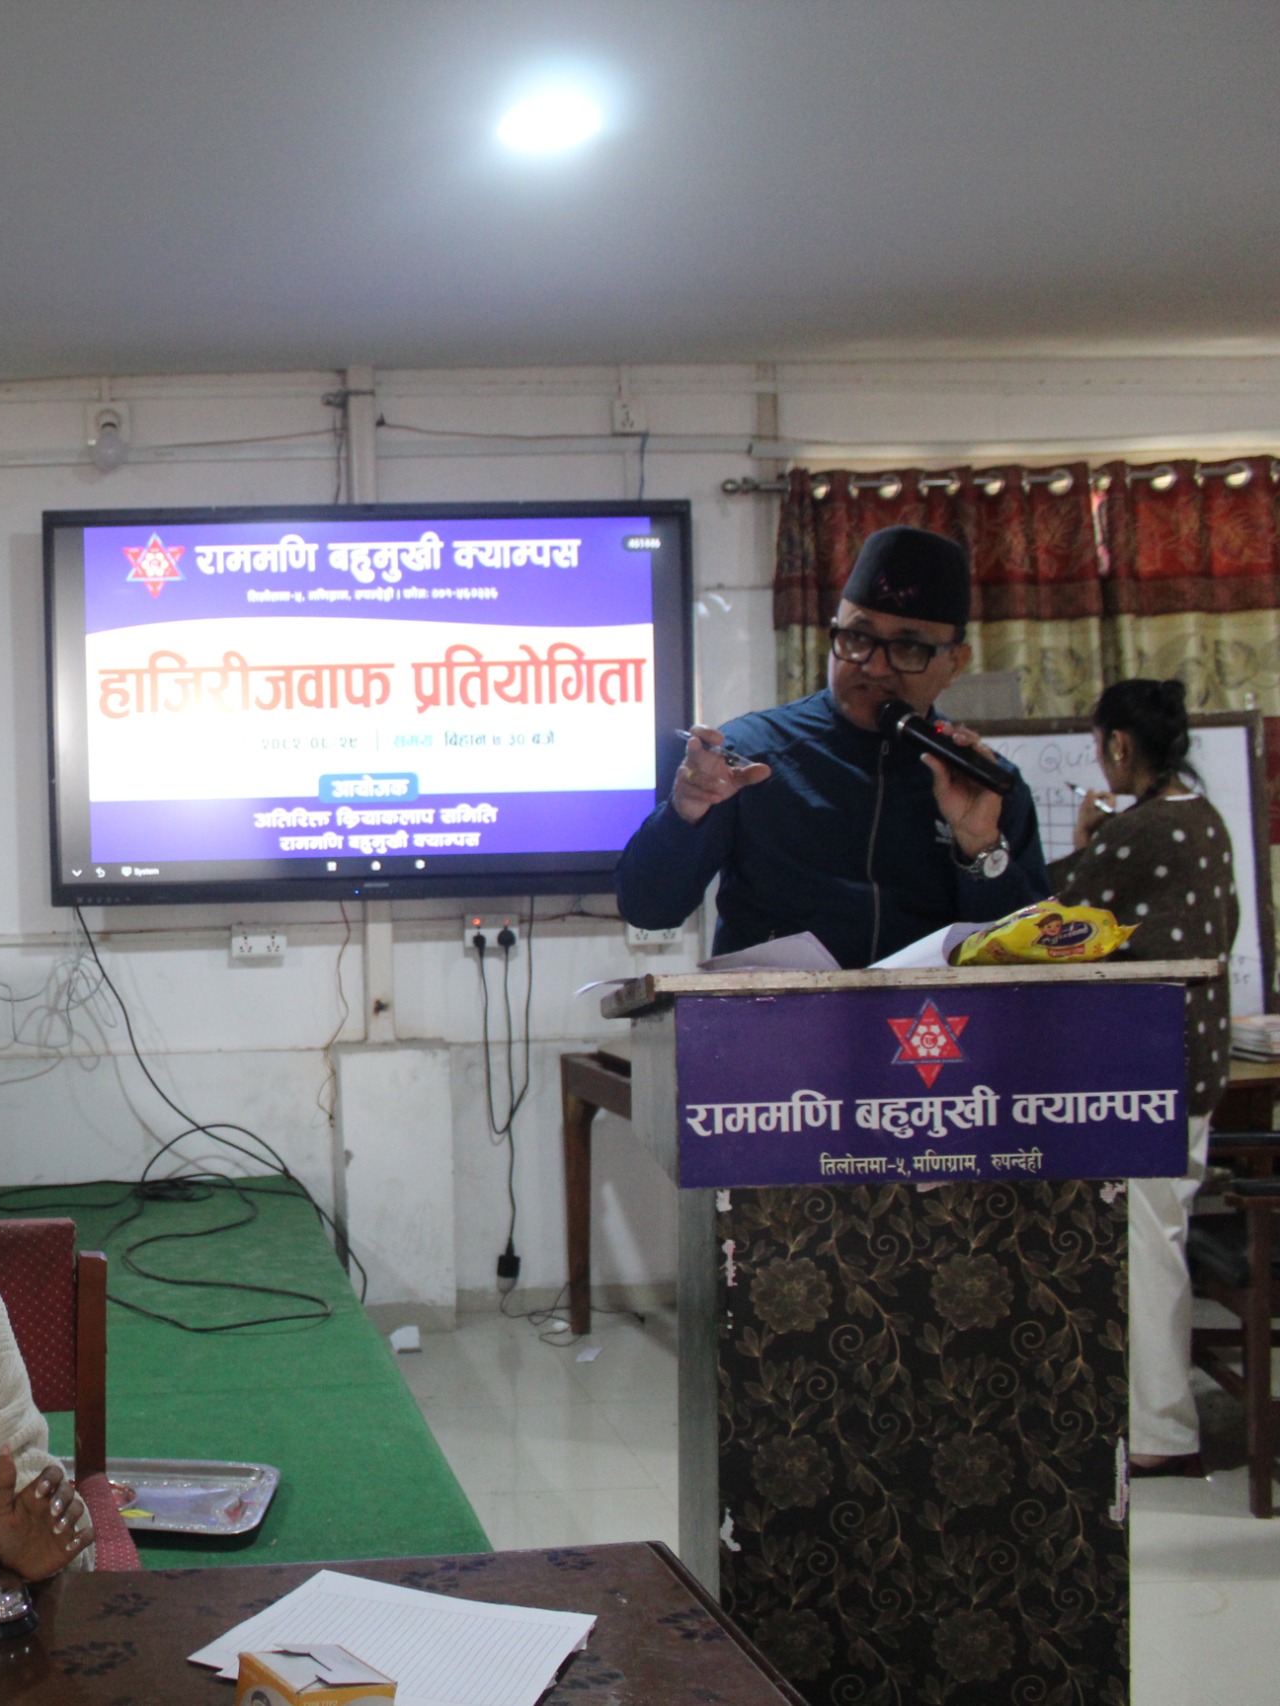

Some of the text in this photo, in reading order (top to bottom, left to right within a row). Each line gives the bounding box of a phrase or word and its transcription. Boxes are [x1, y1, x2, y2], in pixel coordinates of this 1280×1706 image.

[194, 531, 582, 583] राममणि बहुमुखी क्याम्पस
[99, 642, 646, 719] हाजिरीजवाफ प्रतियोगिता
[1037, 743, 1098, 774] Qui
[331, 775, 410, 798] आयोजक
[440, 803, 498, 824] समिति
[279, 830, 481, 854] राममणि बहुमुखी क्याम्पस
[686, 1085, 1178, 1139] राममणि बहुमुखी क्याम्पस
